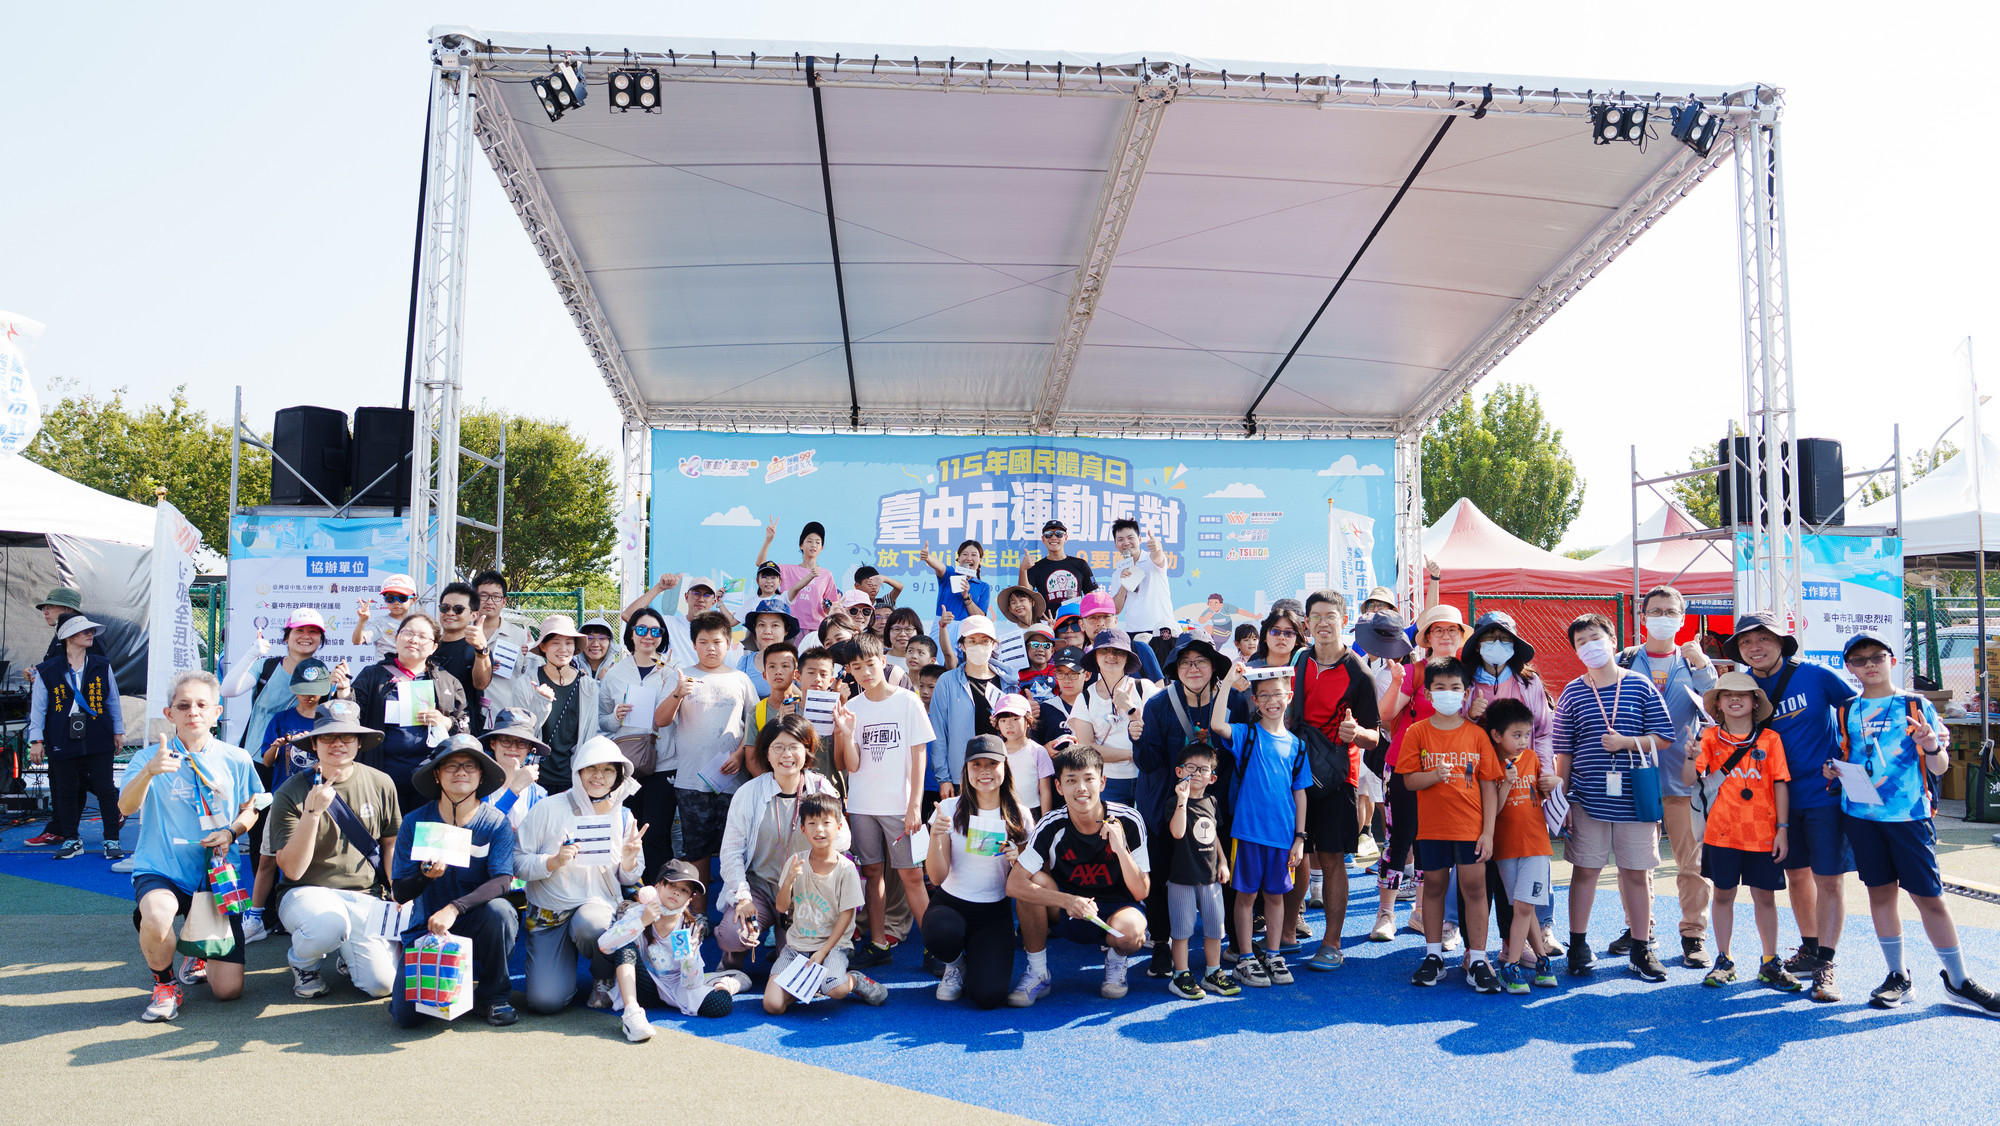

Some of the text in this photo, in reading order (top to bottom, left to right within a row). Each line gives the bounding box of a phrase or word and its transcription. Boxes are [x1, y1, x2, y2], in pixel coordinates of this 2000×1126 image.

[939, 449, 1127, 487] 115年國民體育日
[876, 481, 1181, 545] 臺中市運動派對
[310, 561, 364, 574] 協辦單位
[1801, 586, 1838, 598] 合作夥伴
[271, 602, 341, 610] 臺中市政府環境保護局
[1823, 612, 1893, 625] 臺中市孔廟忠烈祠
[1068, 864, 1113, 885] AXA
